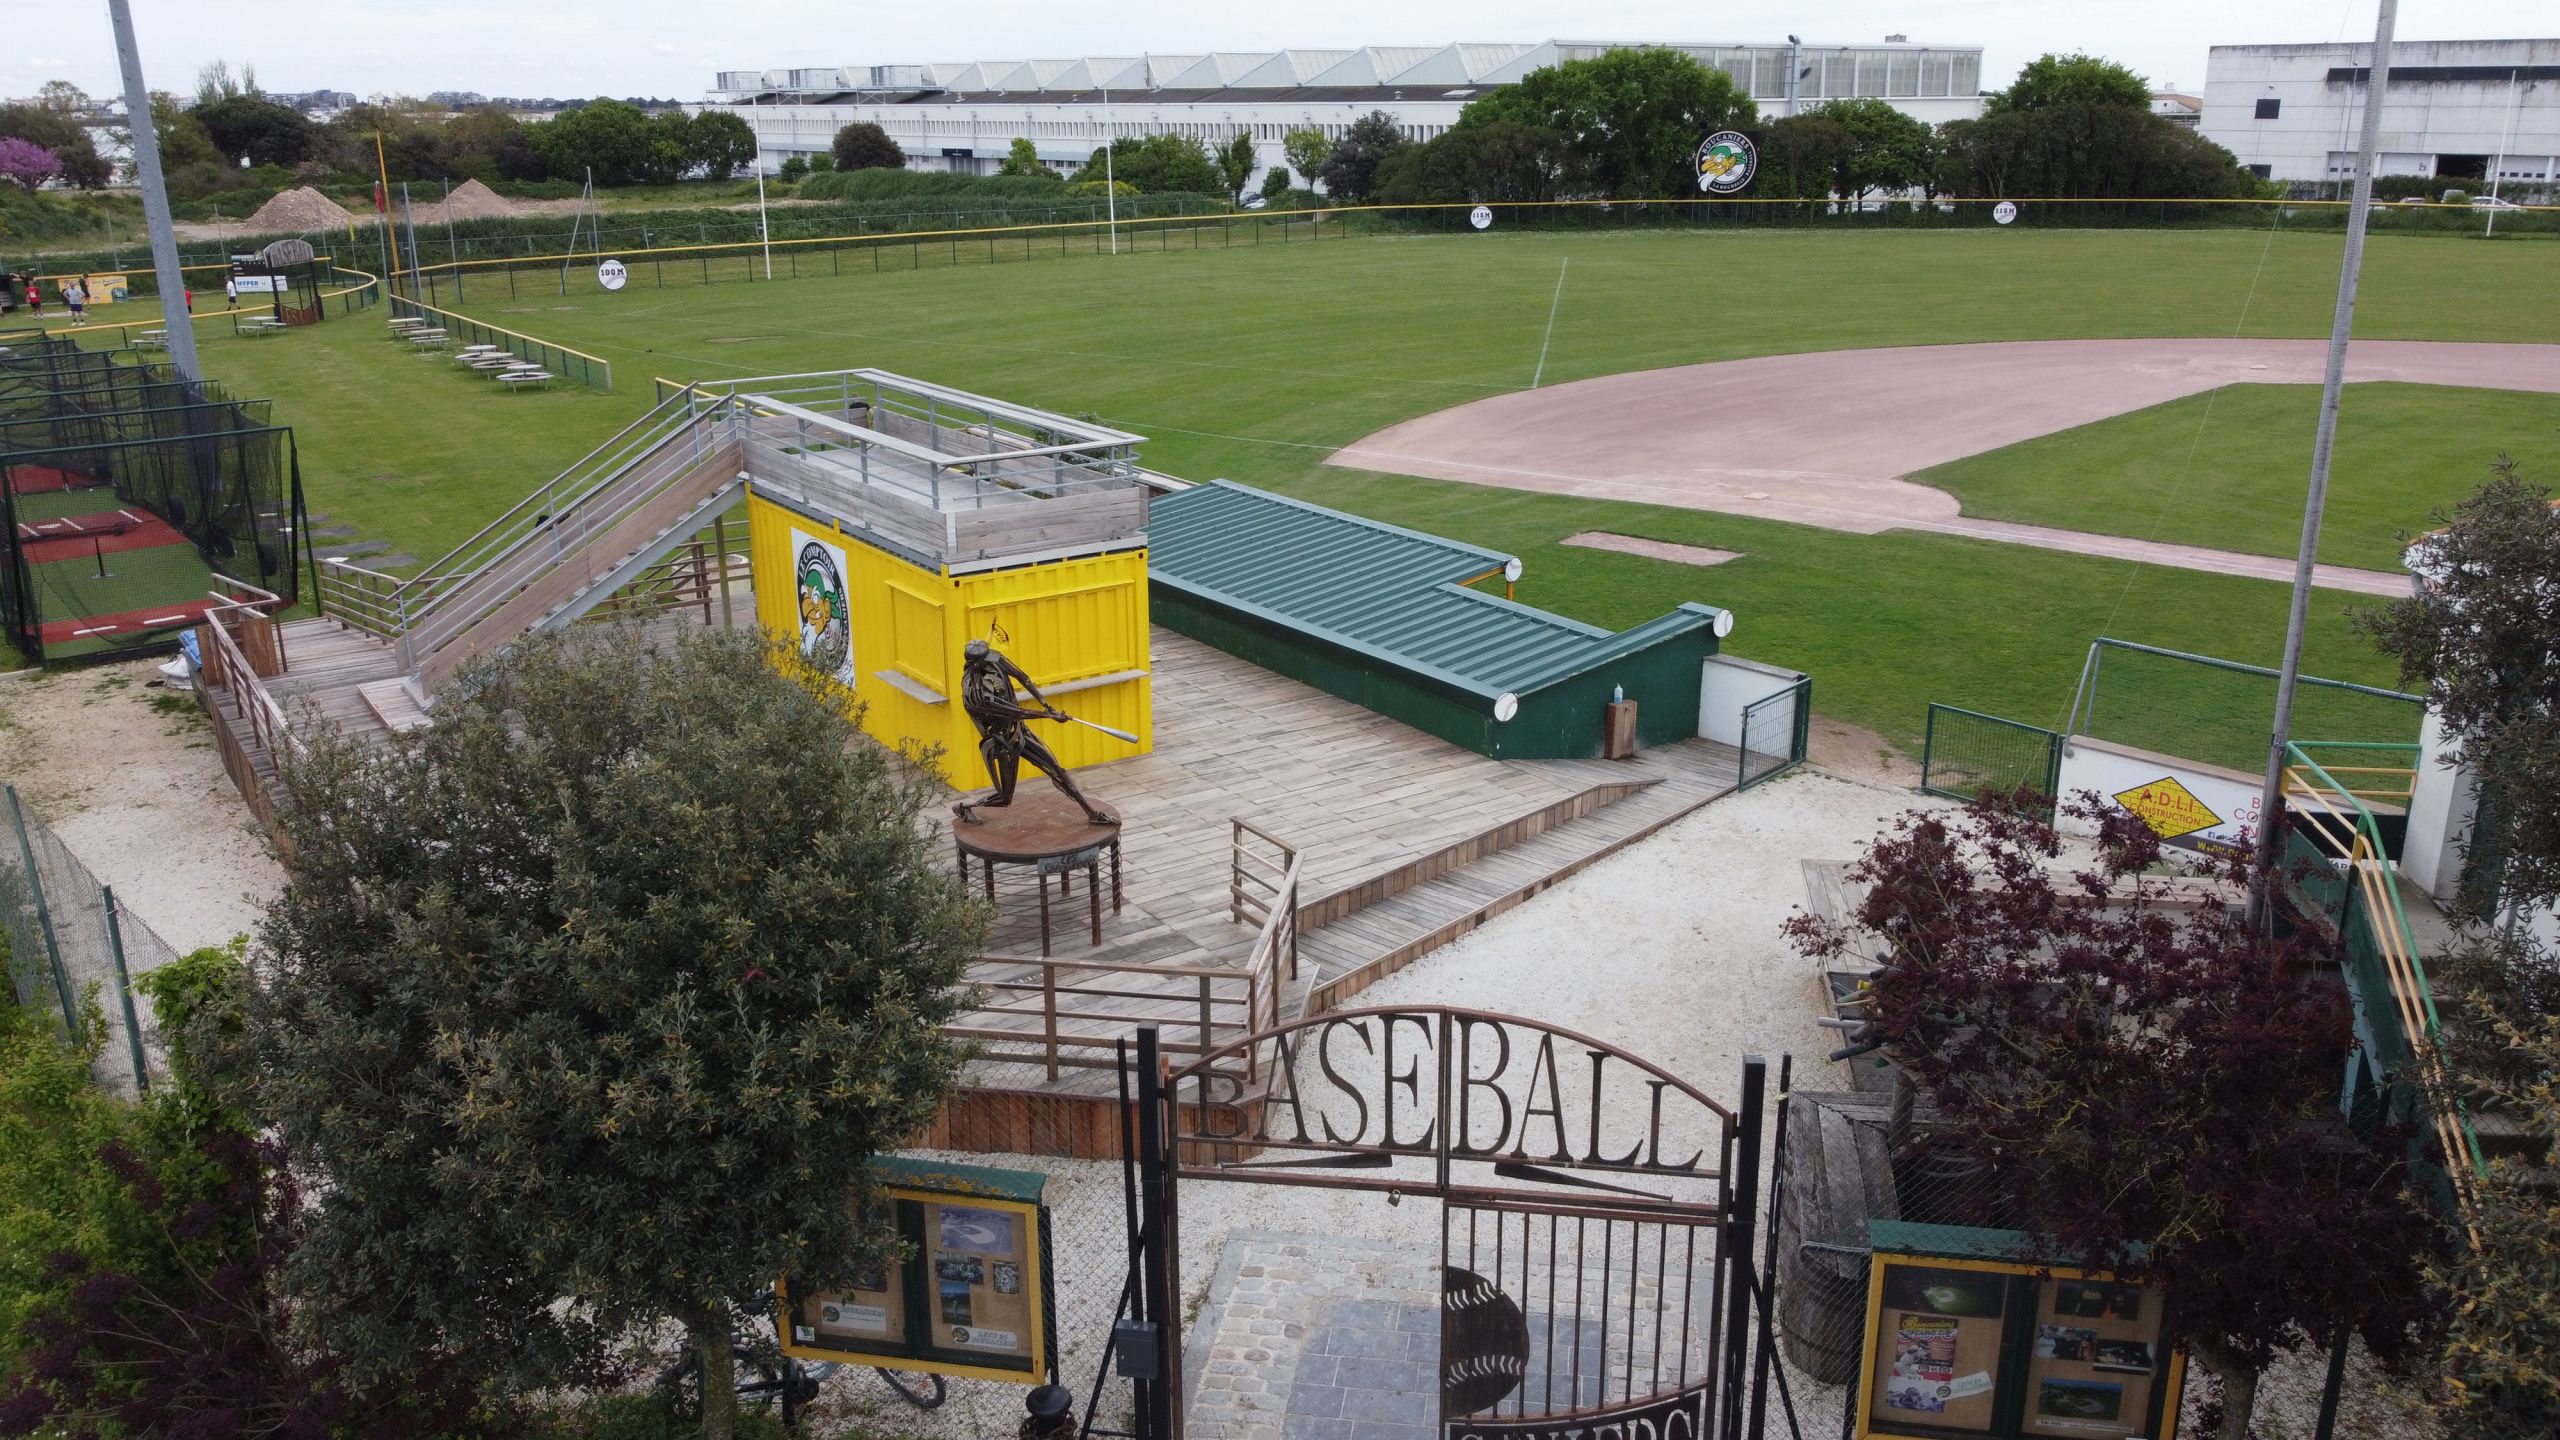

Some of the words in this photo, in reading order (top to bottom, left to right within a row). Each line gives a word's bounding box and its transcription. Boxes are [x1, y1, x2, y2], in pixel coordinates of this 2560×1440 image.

[1702, 134, 1750, 154] BOUCANIERS
[803, 545, 836, 577] COMPTOIR
[2141, 788, 2193, 812] A.D.L.I
[2129, 802, 2201, 826] CONSTRUCTION
[1193, 1013, 1703, 1171] BASEBALL
